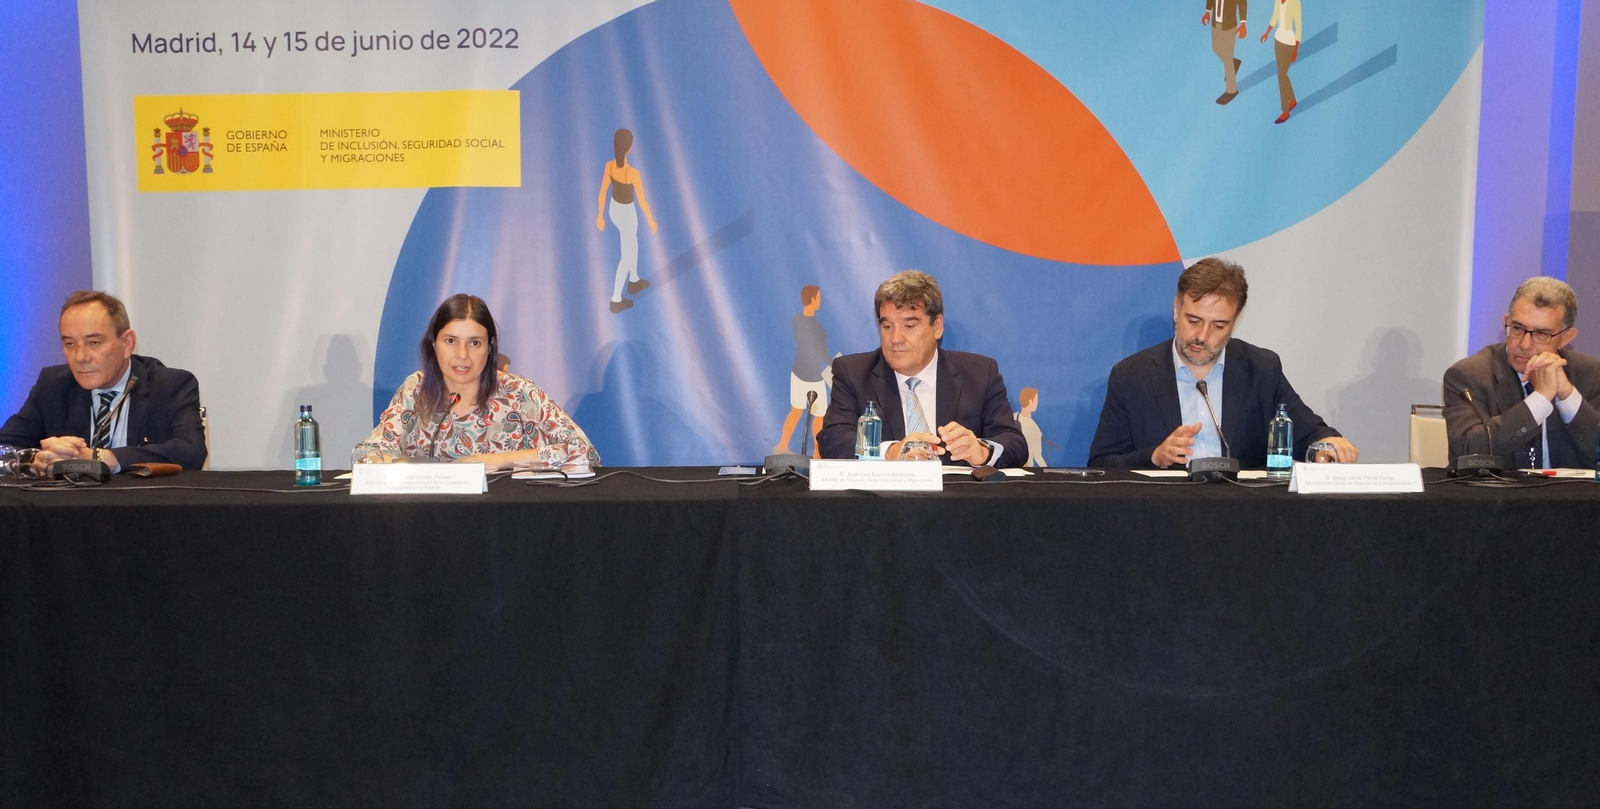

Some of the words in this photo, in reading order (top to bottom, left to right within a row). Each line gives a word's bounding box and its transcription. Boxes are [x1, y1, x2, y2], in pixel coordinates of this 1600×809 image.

[131, 32, 223, 56] Madrid,
[231, 31, 257, 53] 14
[263, 36, 277, 58] y
[283, 31, 308, 52] 15
[314, 31, 346, 52] de
[351, 30, 414, 58] junio
[420, 29, 451, 51] de
[456, 27, 519, 49] 2022
[226, 129, 288, 140] GOBIERNO
[319, 128, 381, 138] MINISTERIO
[226, 142, 242, 153] DE
[245, 140, 288, 153] ESPAÑA
[320, 141, 335, 151] DE
[337, 138, 400, 151] INCLUSIÓN,
[402, 139, 462, 150] SEGURIDAD
[464, 138, 505, 148] SOCIAL
[320, 154, 327, 163] Y
[330, 153, 405, 163] MIGRACIONES
[62, 463, 91, 471] BOSCH
